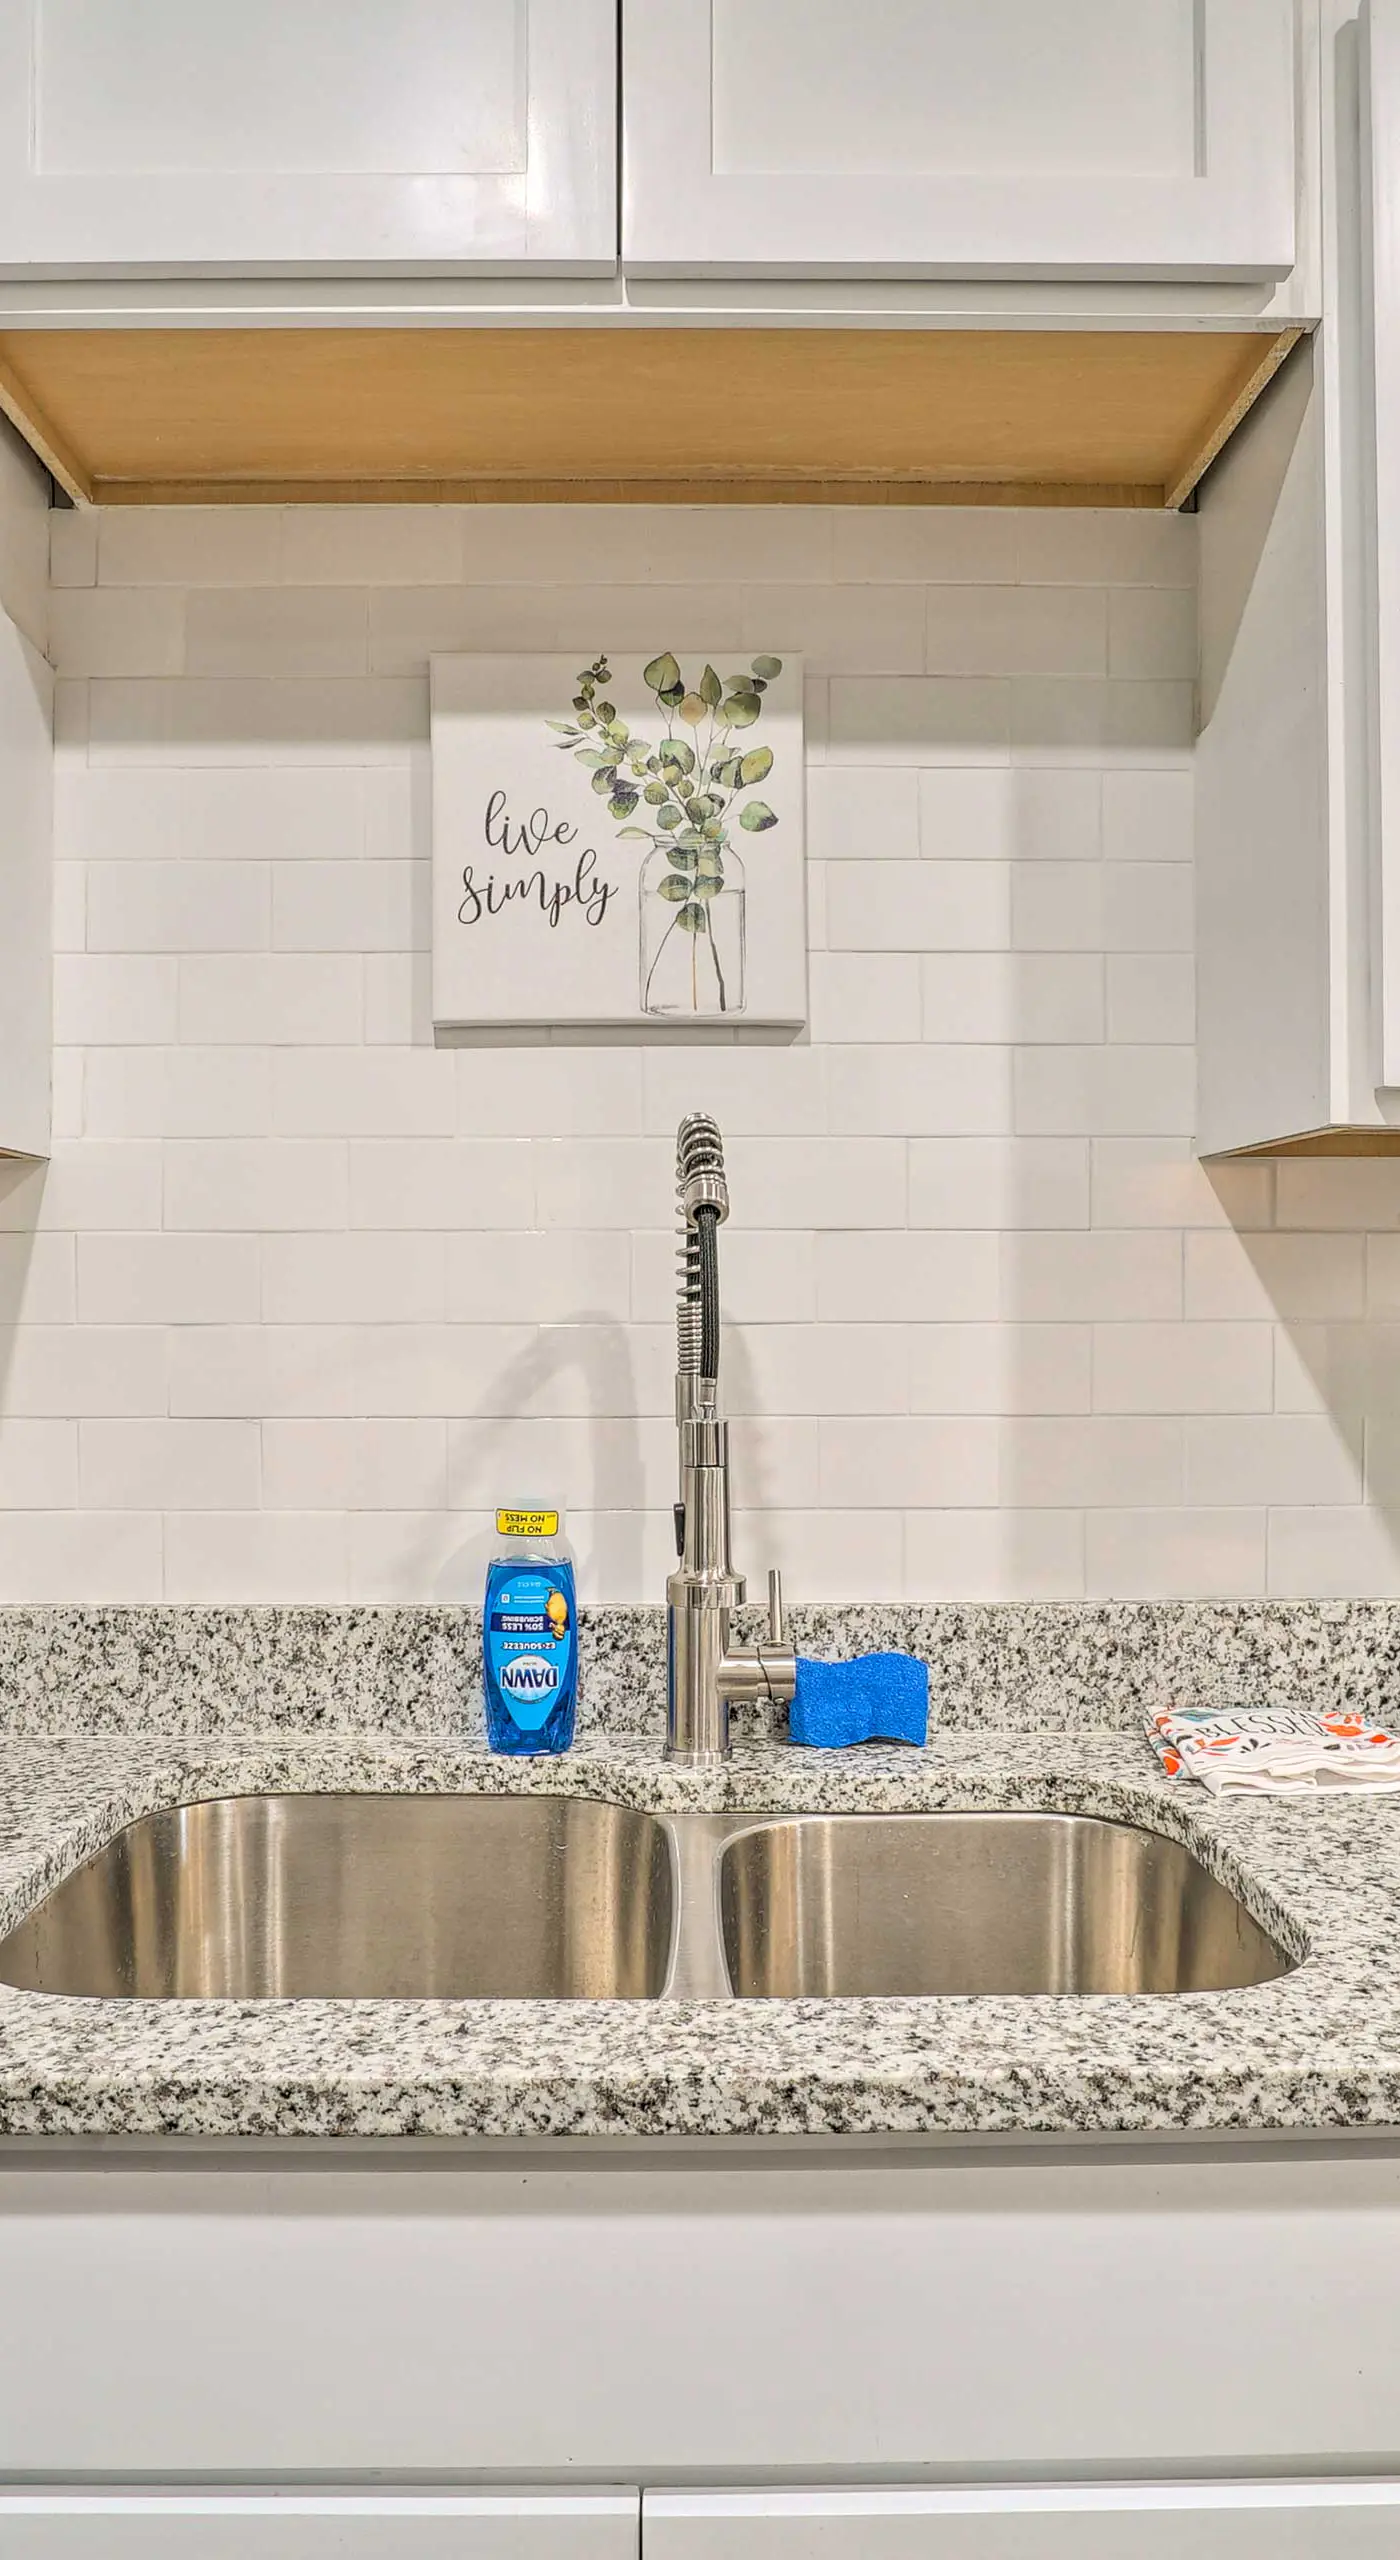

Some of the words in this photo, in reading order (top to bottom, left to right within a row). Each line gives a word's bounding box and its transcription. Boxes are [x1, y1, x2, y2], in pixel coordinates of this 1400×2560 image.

[485, 790, 579, 856] live
[458, 848, 619, 928] simply
[505, 1513, 528, 1523] MESS
[530, 1514, 545, 1523] NO
[507, 1525, 525, 1533] FLIP
[527, 1525, 542, 1534] NO
[502, 1622, 523, 1631] LESS
[525, 1622, 544, 1631] 50%
[501, 1667, 558, 1689] DAWN
